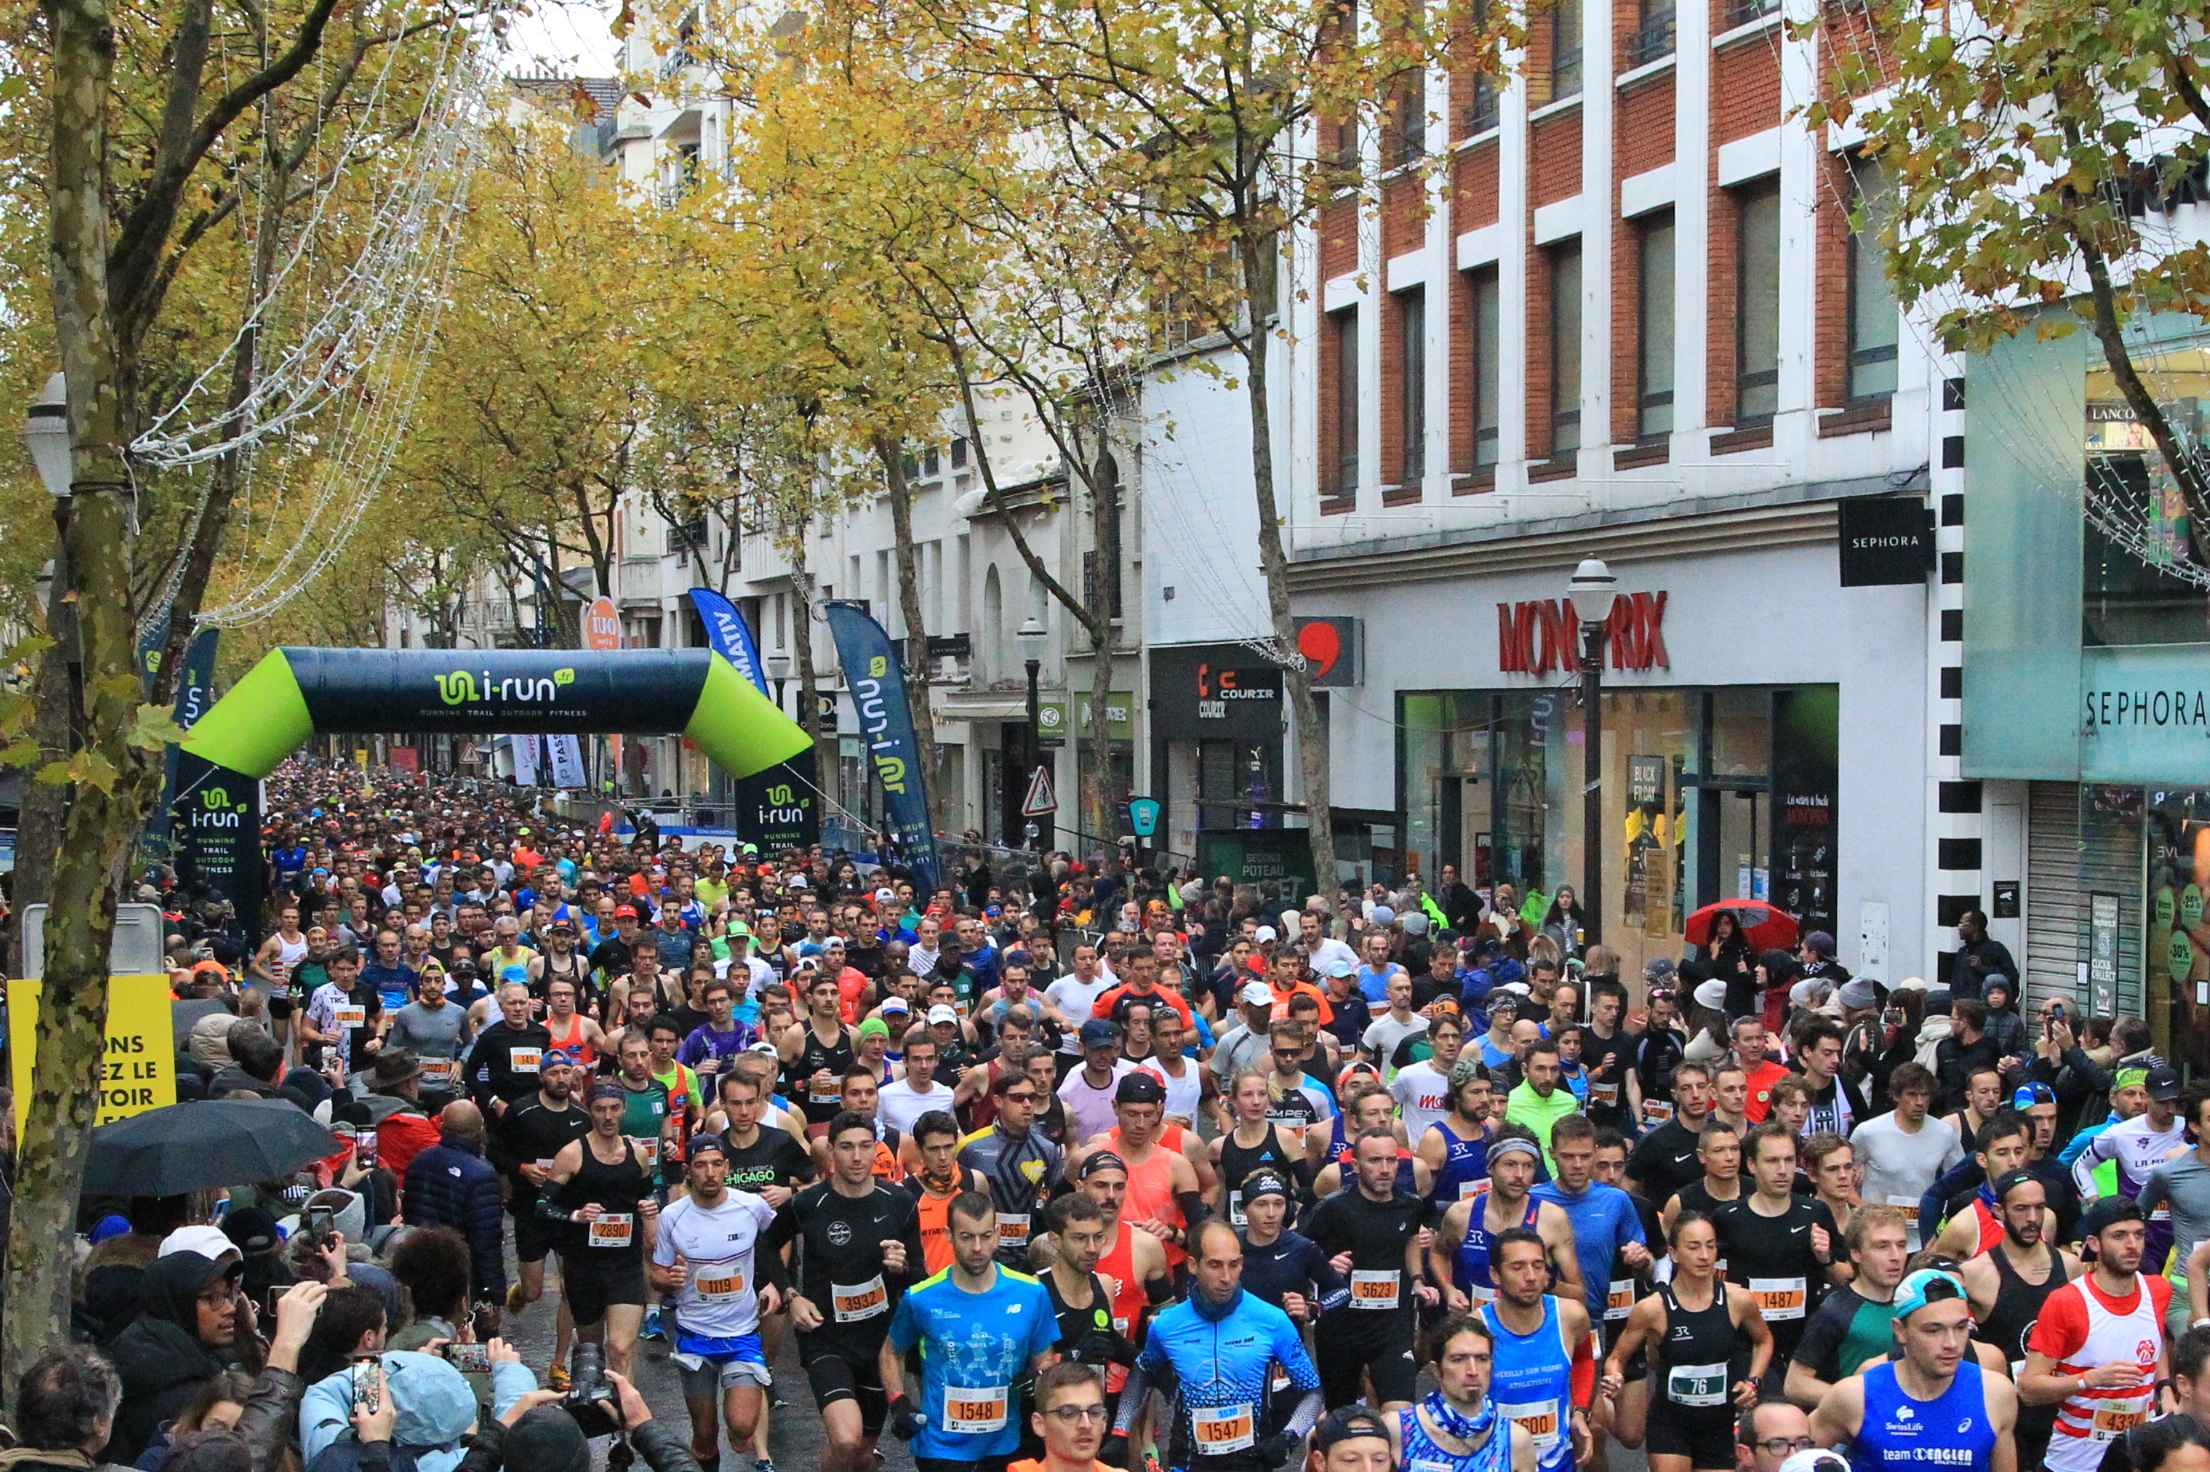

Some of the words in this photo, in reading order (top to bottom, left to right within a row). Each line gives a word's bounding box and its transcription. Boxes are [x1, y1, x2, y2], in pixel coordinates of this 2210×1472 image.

[1852, 536, 1919, 548] SEPHORA
[483, 670, 555, 701] i-run
[1220, 689, 1274, 699] COURIR
[467, 709, 494, 717] TRAIL
[550, 709, 587, 717] FITNESS
[2086, 690, 2207, 726] SEPHORA
[192, 807, 239, 828] i-run
[758, 804, 803, 824] i-run
[764, 832, 801, 840] RUNNING
[1242, 864, 1285, 877] POTEAU
[2091, 969, 2116, 981] COLLECT
[133, 1062, 157, 1079] LE
[600, 1224, 625, 1238] 2890
[708, 1280, 731, 1294] 1119
[1362, 1282, 1391, 1298] 5623
[845, 1291, 877, 1311] 3932
[1763, 1291, 1793, 1308] 1487
[1690, 1378, 1708, 1395] 76
[959, 1402, 993, 1420] 1548
[1206, 1420, 1239, 1442] 1547
[1883, 1449, 1911, 1461] team
